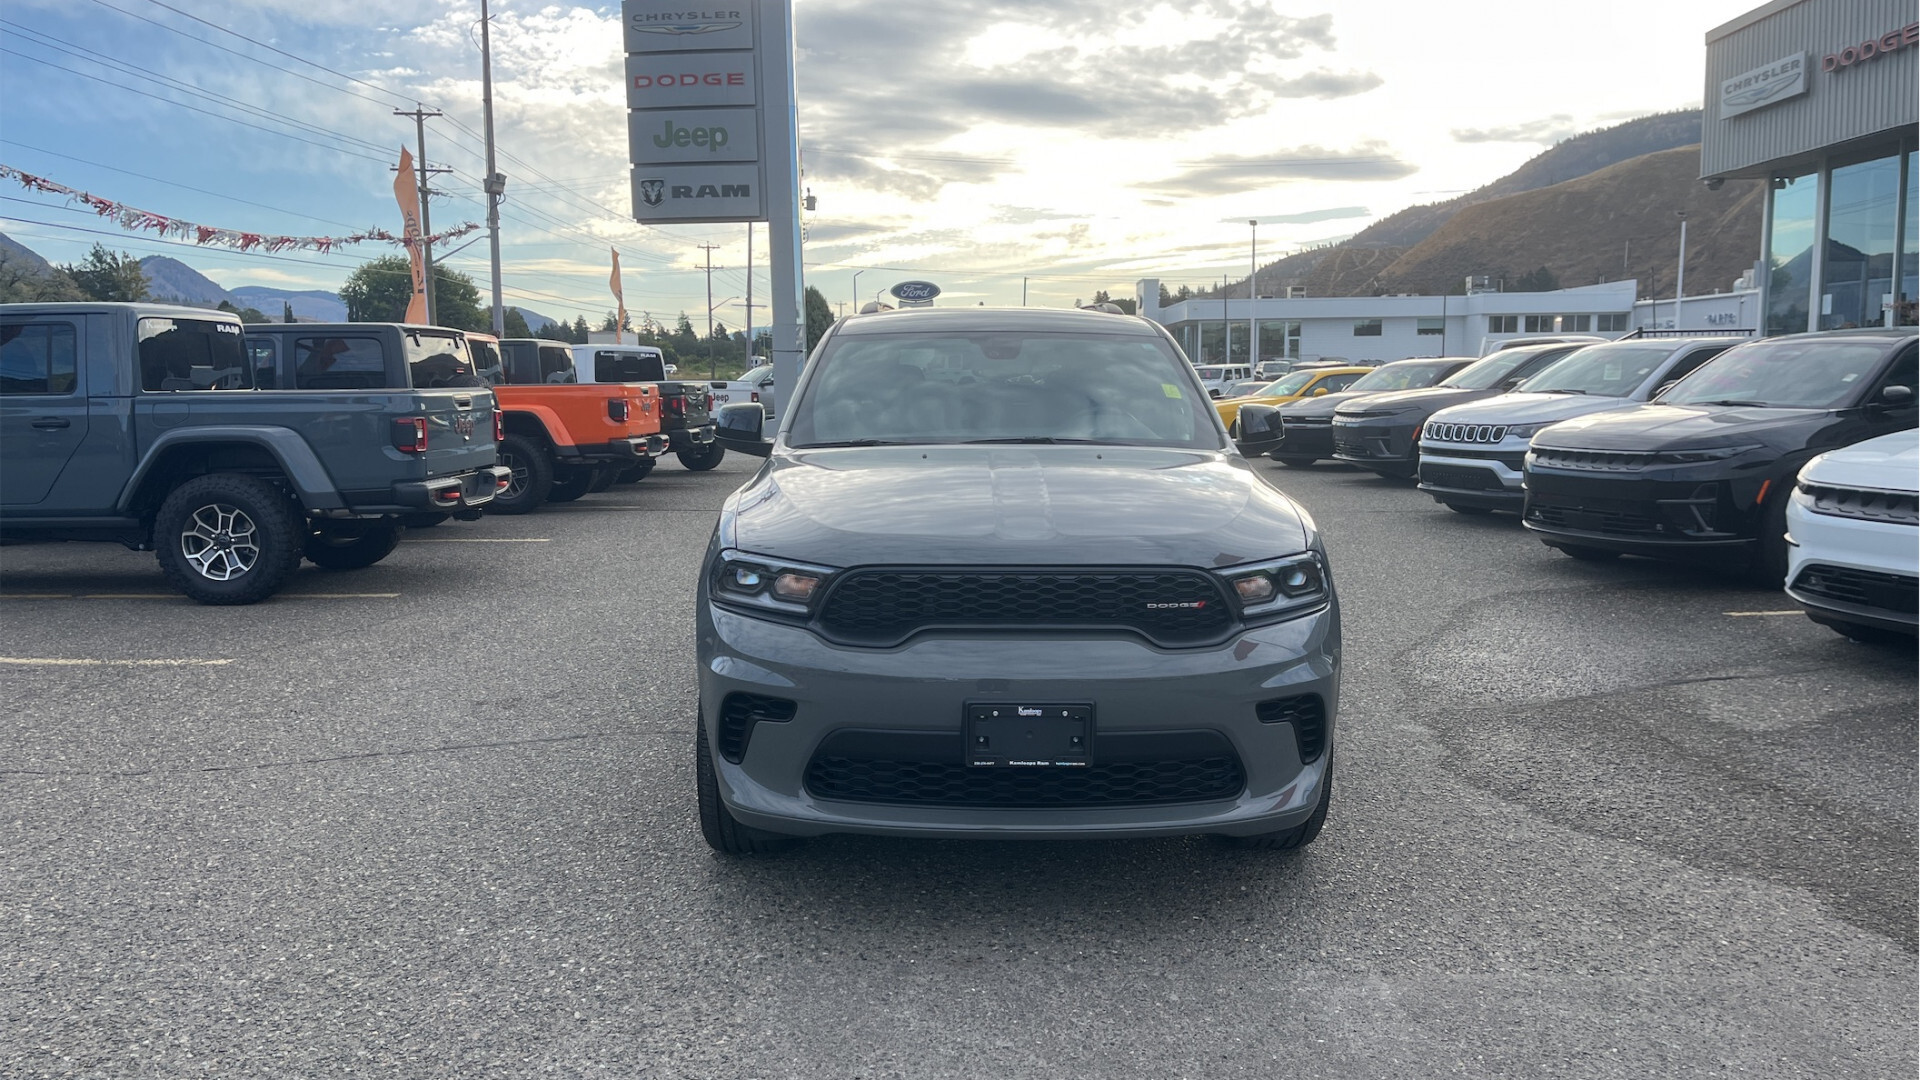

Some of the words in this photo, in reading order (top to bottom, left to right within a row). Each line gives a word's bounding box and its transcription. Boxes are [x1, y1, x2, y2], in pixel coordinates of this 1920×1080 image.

[632, 11, 741, 22] CHRYSLER
[1821, 21, 1919, 73] DODGE
[634, 72, 745, 89] DODGE
[1724, 59, 1801, 95] CHRYSLER
[653, 120, 729, 152] Jeep
[671, 184, 750, 199] RAM
[900, 284, 931, 297] Ford
[216, 324, 240, 335] RAM
[712, 392, 730, 404] Jeep
